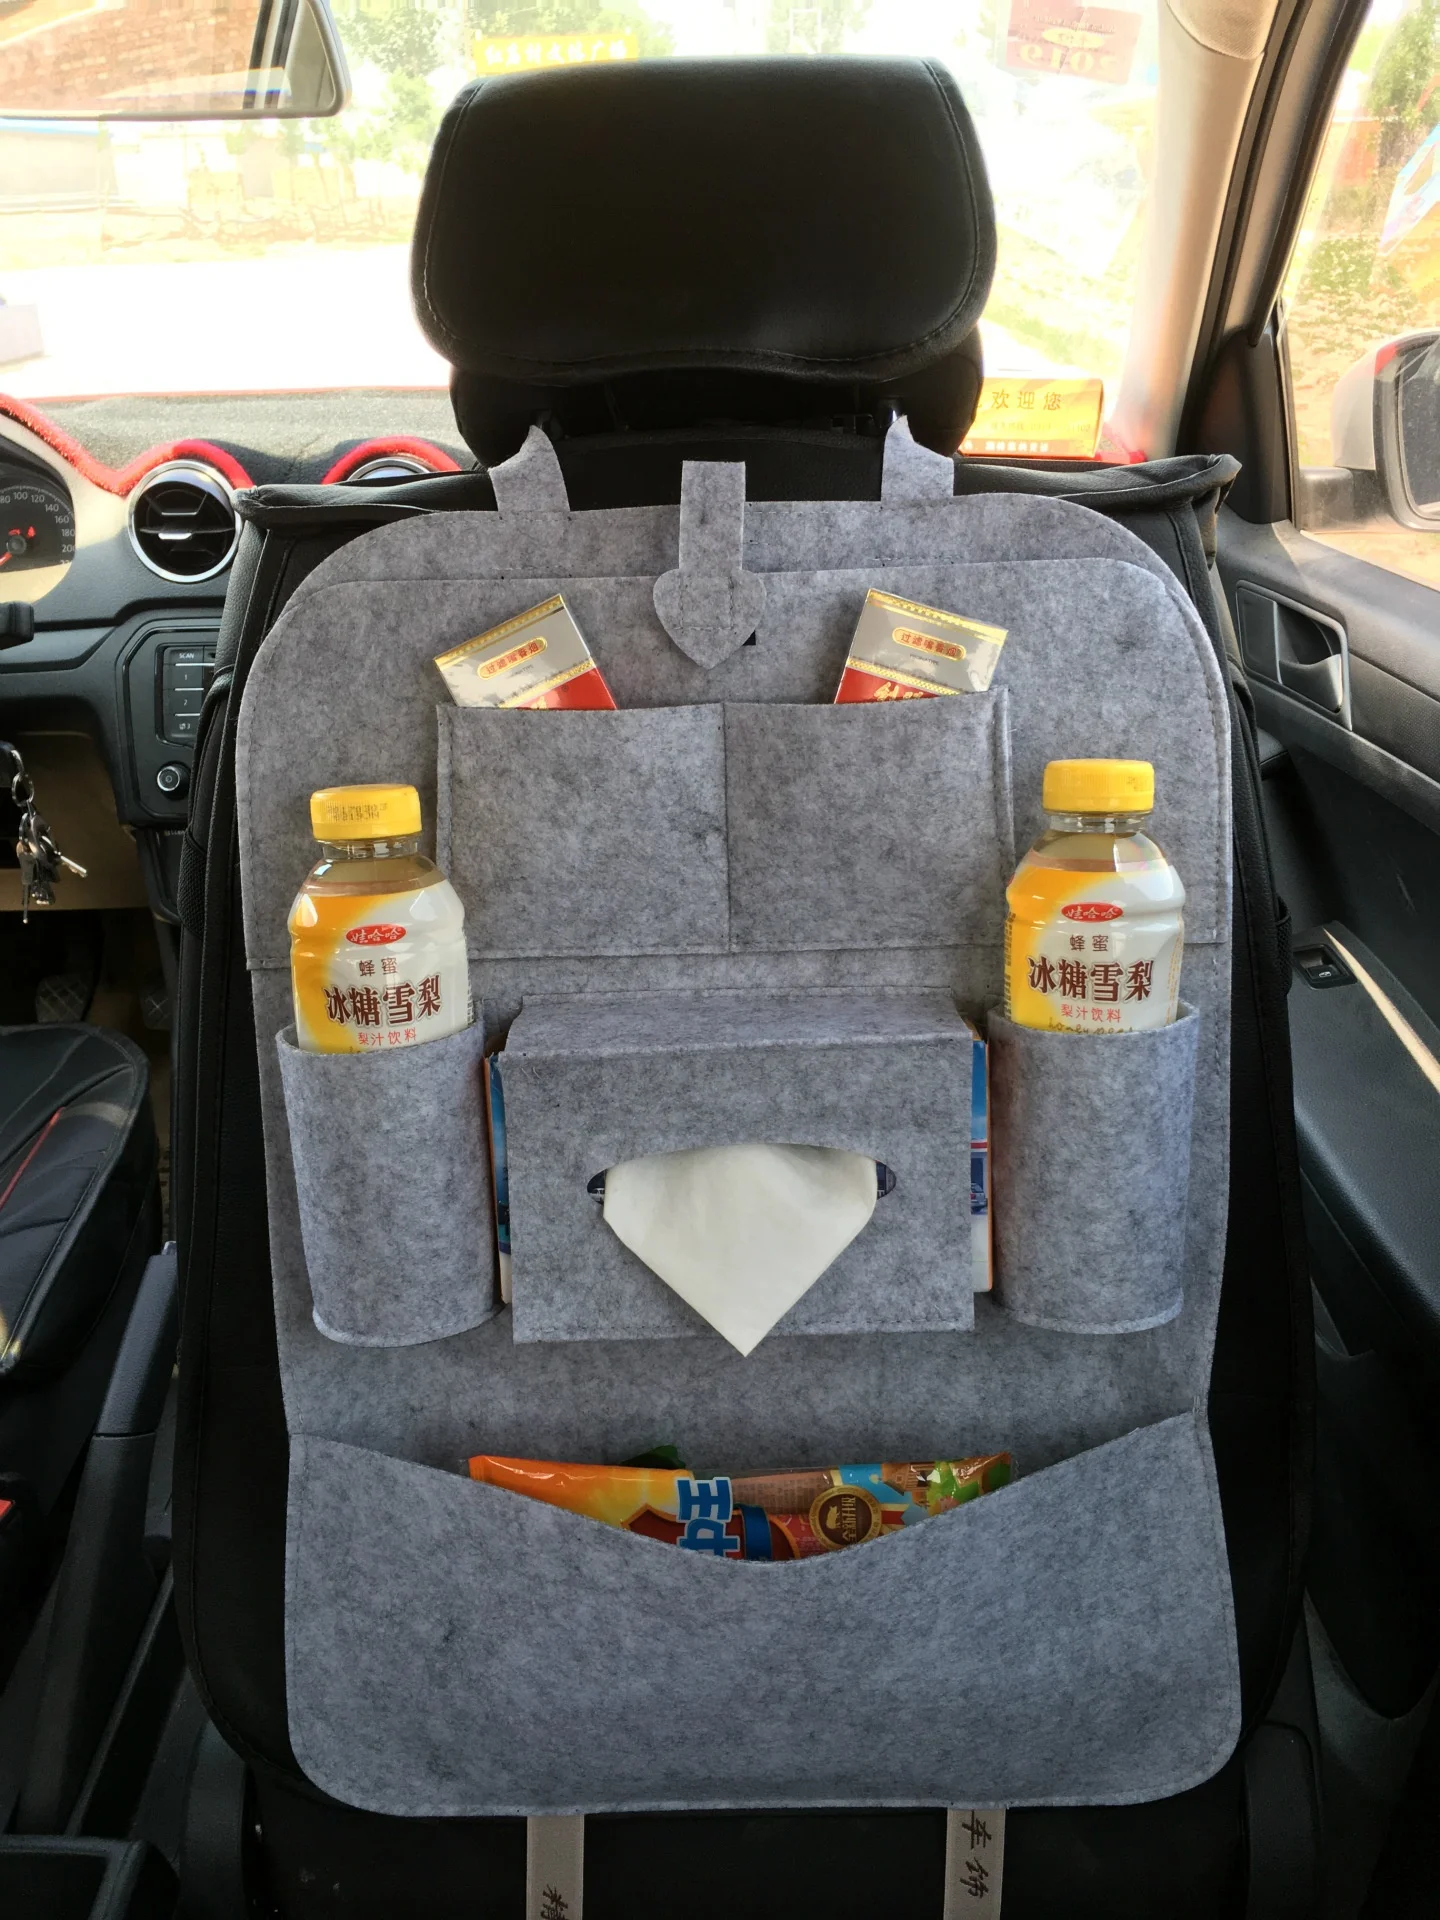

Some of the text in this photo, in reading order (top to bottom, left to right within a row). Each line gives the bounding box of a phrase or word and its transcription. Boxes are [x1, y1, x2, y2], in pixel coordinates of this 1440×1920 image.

[978, 389, 1062, 411] 欢迎您
[13, 491, 28, 500] 100
[31, 494, 45, 503] 120
[45, 503, 59, 512] 140
[55, 515, 69, 524] 160
[179, 652, 195, 660] SCAN
[183, 698, 188, 706] 2
[1066, 906, 1115, 920] 娃哈哈
[351, 929, 401, 944] 娃哈哈
[1069, 935, 1109, 952] 蜂蜜
[359, 957, 398, 977] 蜂蜜
[1028, 956, 1154, 1002] 冰糖雪梨
[323, 974, 442, 1026] 冰糖雪梨
[1061, 1003, 1121, 1023] 梨汁饮料
[358, 1027, 417, 1047] 梨汁饮料
